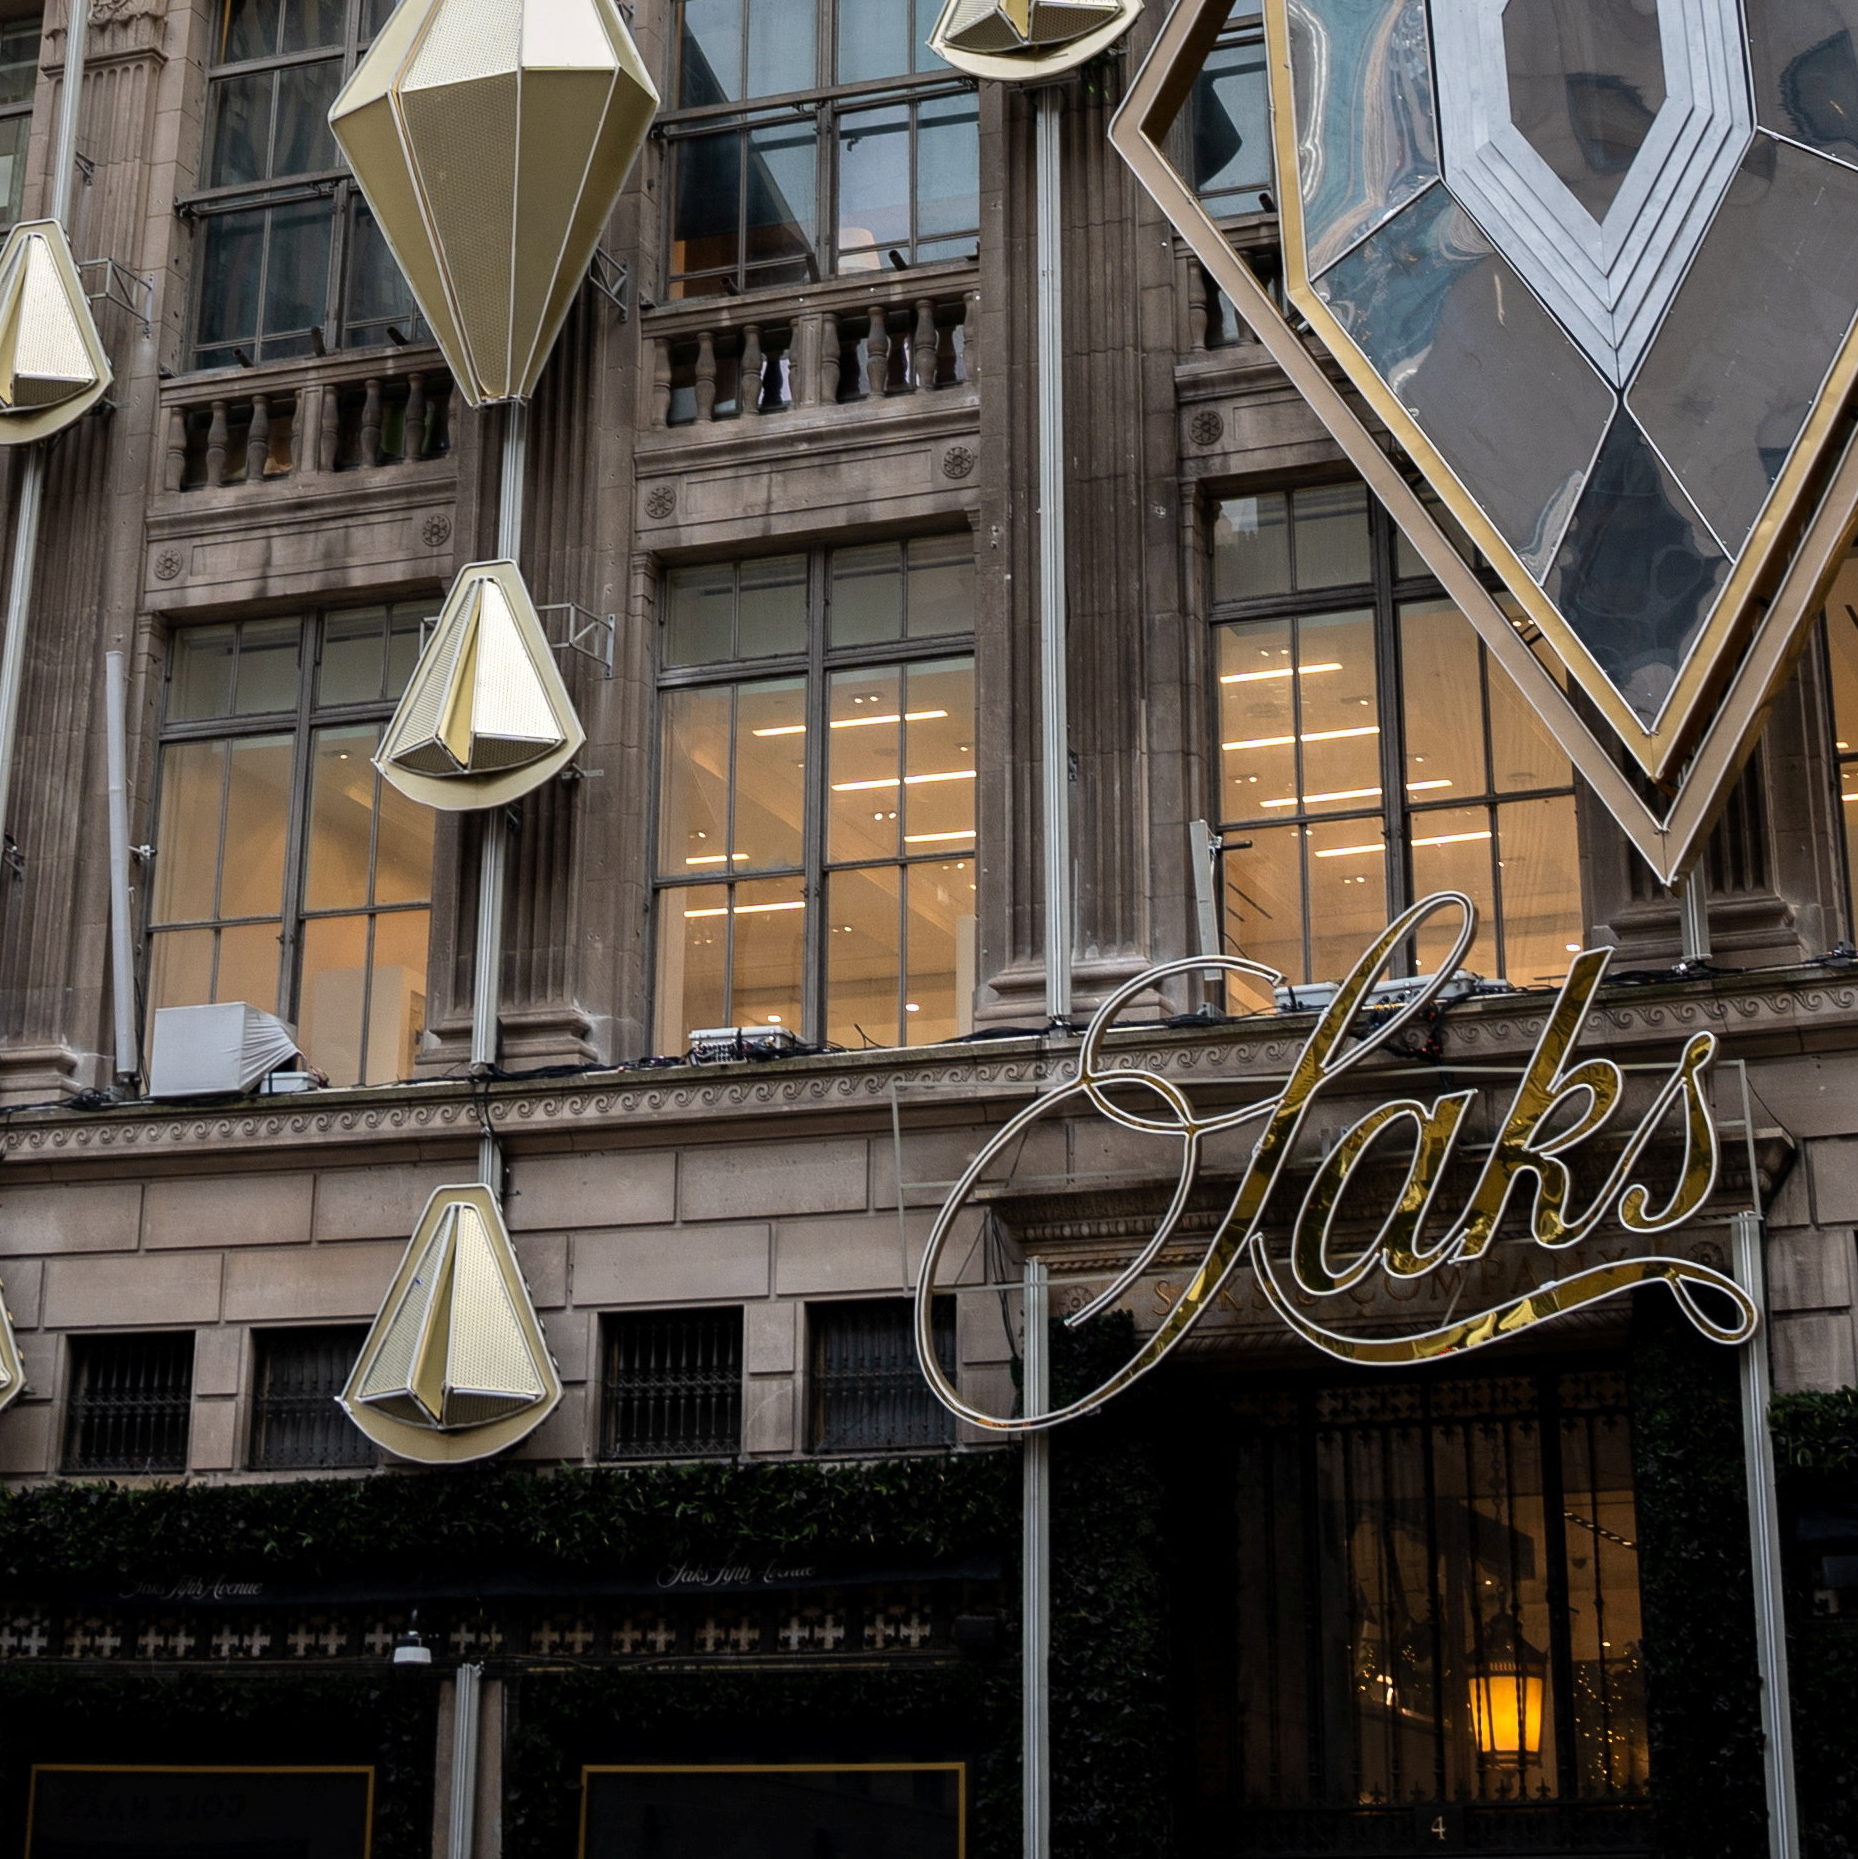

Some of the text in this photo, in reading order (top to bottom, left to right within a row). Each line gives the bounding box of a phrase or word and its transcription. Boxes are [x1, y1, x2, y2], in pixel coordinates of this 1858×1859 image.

[915, 890, 1761, 1432] Saks
[1151, 1274, 1271, 1316] SKS
[203, 1571, 264, 1601] Avenue
[656, 1557, 709, 1588] Saks
[701, 1557, 753, 1587] Fifth
[1430, 1814, 1447, 1841] 4
